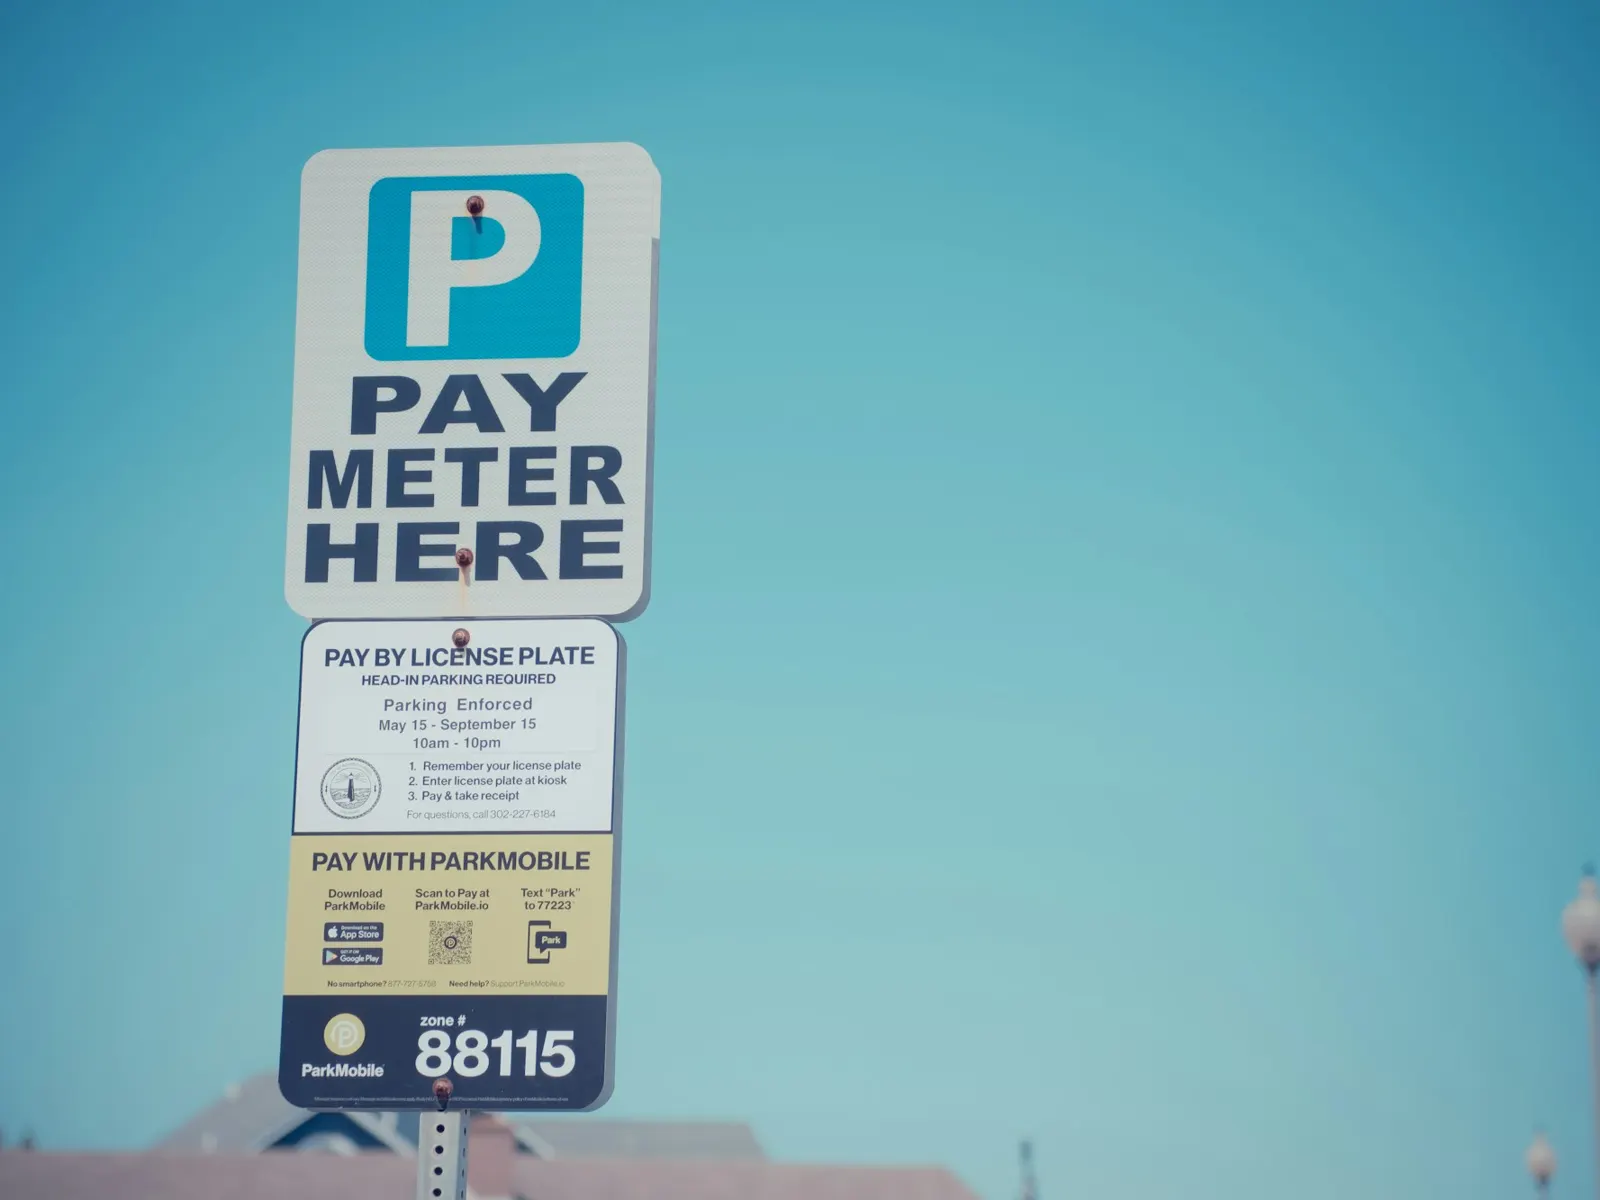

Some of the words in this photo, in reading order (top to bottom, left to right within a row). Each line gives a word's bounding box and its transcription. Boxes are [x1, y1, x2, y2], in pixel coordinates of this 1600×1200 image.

[406, 189, 541, 347] P
[350, 372, 588, 435] PAY
[307, 446, 625, 509] METER
[304, 519, 623, 583] HERE
[325, 648, 370, 666] PAY
[374, 648, 406, 666] BY
[411, 647, 514, 666] LICENSE
[519, 646, 595, 665] PLATE
[362, 675, 419, 686] HEAD-IN
[422, 674, 483, 685] PARKING
[486, 674, 556, 685] REQUIRED
[384, 699, 446, 714] Parking
[457, 698, 532, 711] Enforced
[379, 720, 406, 733] May
[412, 719, 427, 730] 15
[441, 718, 516, 732] September
[522, 718, 536, 729] 15
[413, 738, 450, 749] 10am
[464, 737, 501, 751] 10pm
[409, 762, 416, 771] 1.
[423, 761, 483, 771] Remember
[487, 763, 509, 773] your
[513, 760, 551, 771] license
[554, 760, 582, 773] plate
[408, 777, 418, 786] 2.
[422, 776, 452, 786] Enter
[454, 776, 493, 786] license
[495, 776, 523, 788] plate
[525, 776, 535, 785] at
[538, 775, 567, 785] kiosk
[408, 791, 418, 800] 3.
[422, 791, 442, 804] Pay
[444, 791, 452, 800] &
[455, 790, 478, 800] take
[481, 790, 519, 803] receipt
[407, 810, 421, 819] For
[424, 810, 471, 820] questions,
[473, 810, 488, 818] call
[490, 809, 556, 819] 302-227-6184
[312, 852, 361, 871] PAY
[363, 852, 425, 871] WITH
[431, 851, 590, 870] PARKMOBILE
[328, 888, 382, 898] Download
[415, 889, 441, 898] Scan
[445, 889, 455, 898] to
[458, 888, 477, 900] Pay
[479, 889, 489, 898] at
[521, 888, 543, 897] Text
[325, 901, 385, 911] ParkMobile
[415, 901, 488, 911] ParkMobile.io
[525, 902, 535, 910] to
[538, 901, 571, 910] 77223
[340, 931, 357, 939] App
[340, 955, 364, 963] Google
[366, 955, 379, 963] Play
[420, 1017, 453, 1026] zone
[458, 1015, 465, 1025] #
[415, 1030, 576, 1078] 88115
[302, 1064, 384, 1077] ParkMobile
